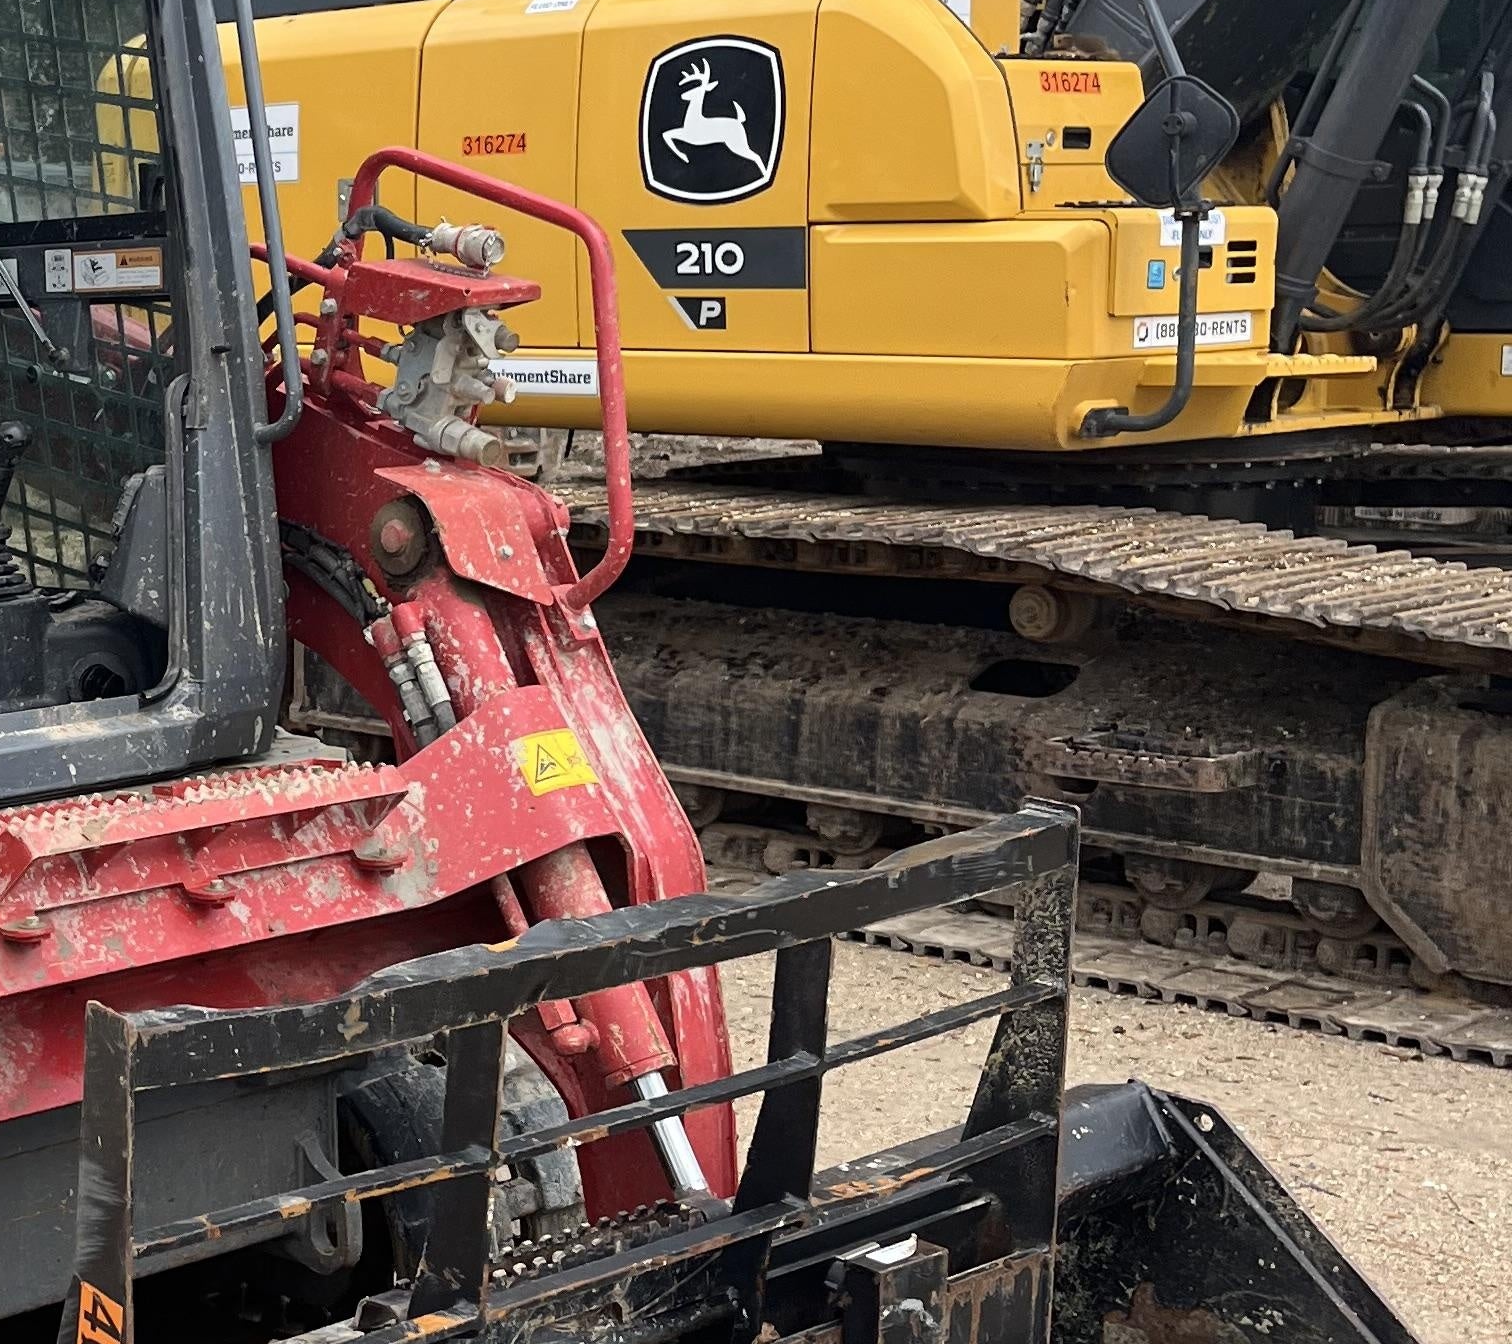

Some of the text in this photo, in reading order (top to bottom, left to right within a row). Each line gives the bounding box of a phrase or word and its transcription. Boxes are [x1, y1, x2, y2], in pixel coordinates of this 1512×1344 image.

[1040, 72, 1101, 94] 316274
[464, 133, 526, 155] 316274
[676, 242, 745, 275] 210
[699, 300, 721, 326] P
